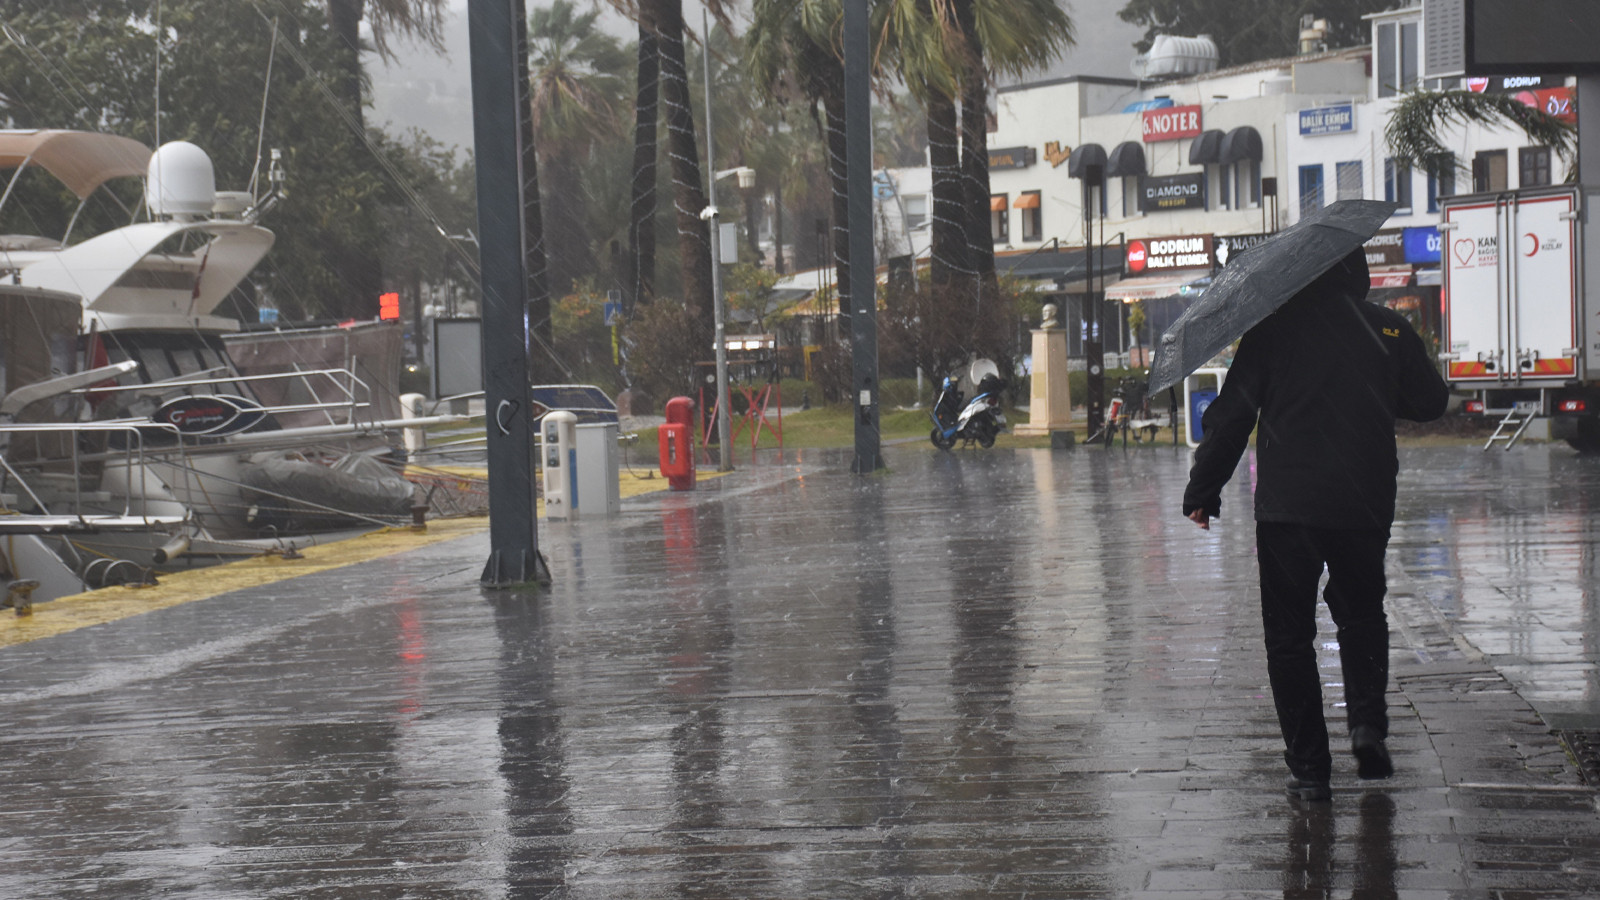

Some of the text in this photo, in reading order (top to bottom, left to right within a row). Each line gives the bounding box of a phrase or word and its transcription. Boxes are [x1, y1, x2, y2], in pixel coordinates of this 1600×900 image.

[1503, 76, 1541, 88] BODRUM
[1152, 111, 1199, 134] NOTER
[1146, 183, 1198, 199] DIAMOND
[1150, 237, 1204, 255] BODRUM
[1478, 236, 1497, 248] KAN
[1147, 252, 1209, 268] BALIK EKMEK
